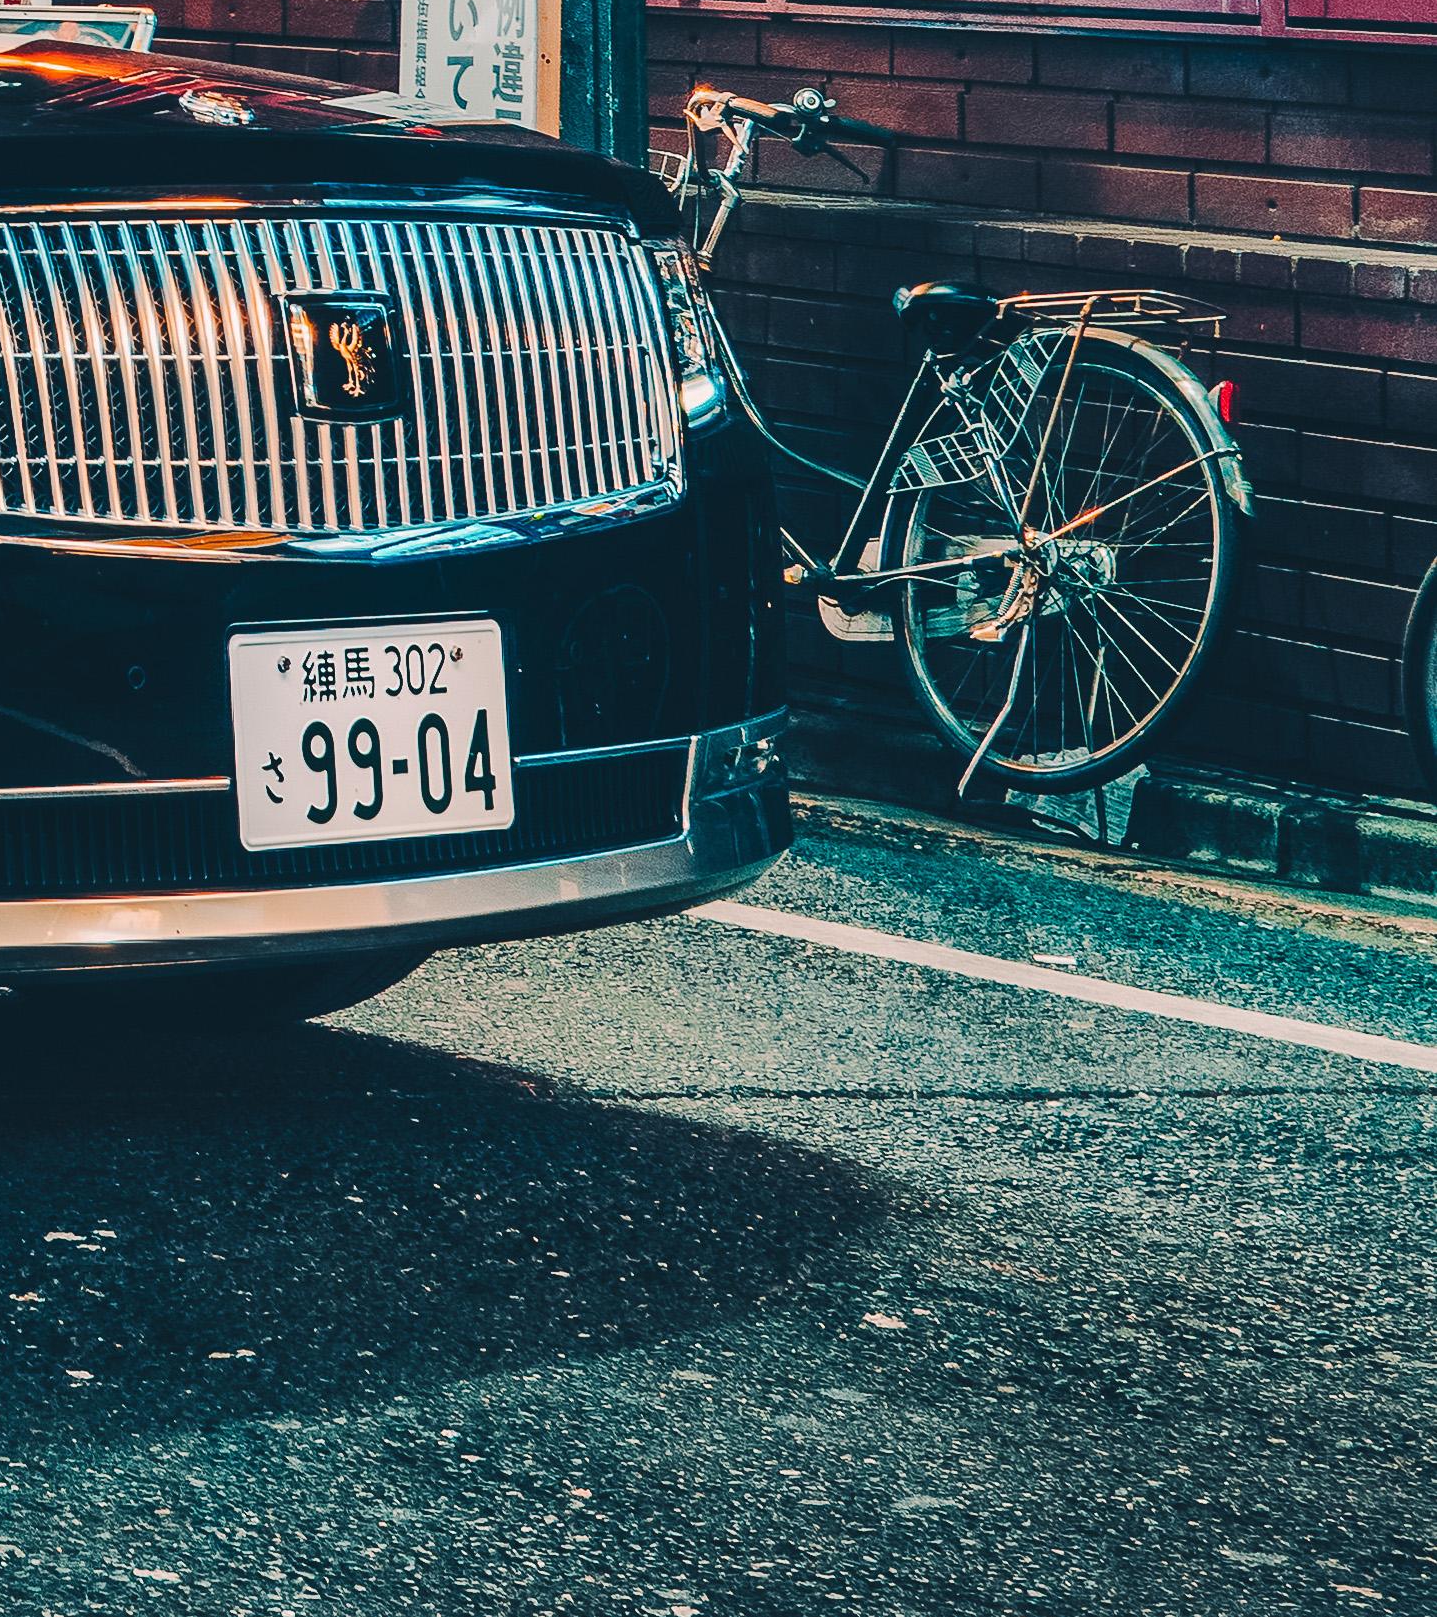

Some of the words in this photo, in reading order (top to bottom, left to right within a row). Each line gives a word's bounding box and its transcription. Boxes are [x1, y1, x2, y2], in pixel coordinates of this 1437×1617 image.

[300, 646, 377, 704] 練馬
[384, 641, 449, 698] 302
[261, 750, 286, 806] さ
[300, 708, 498, 826] 99-04
